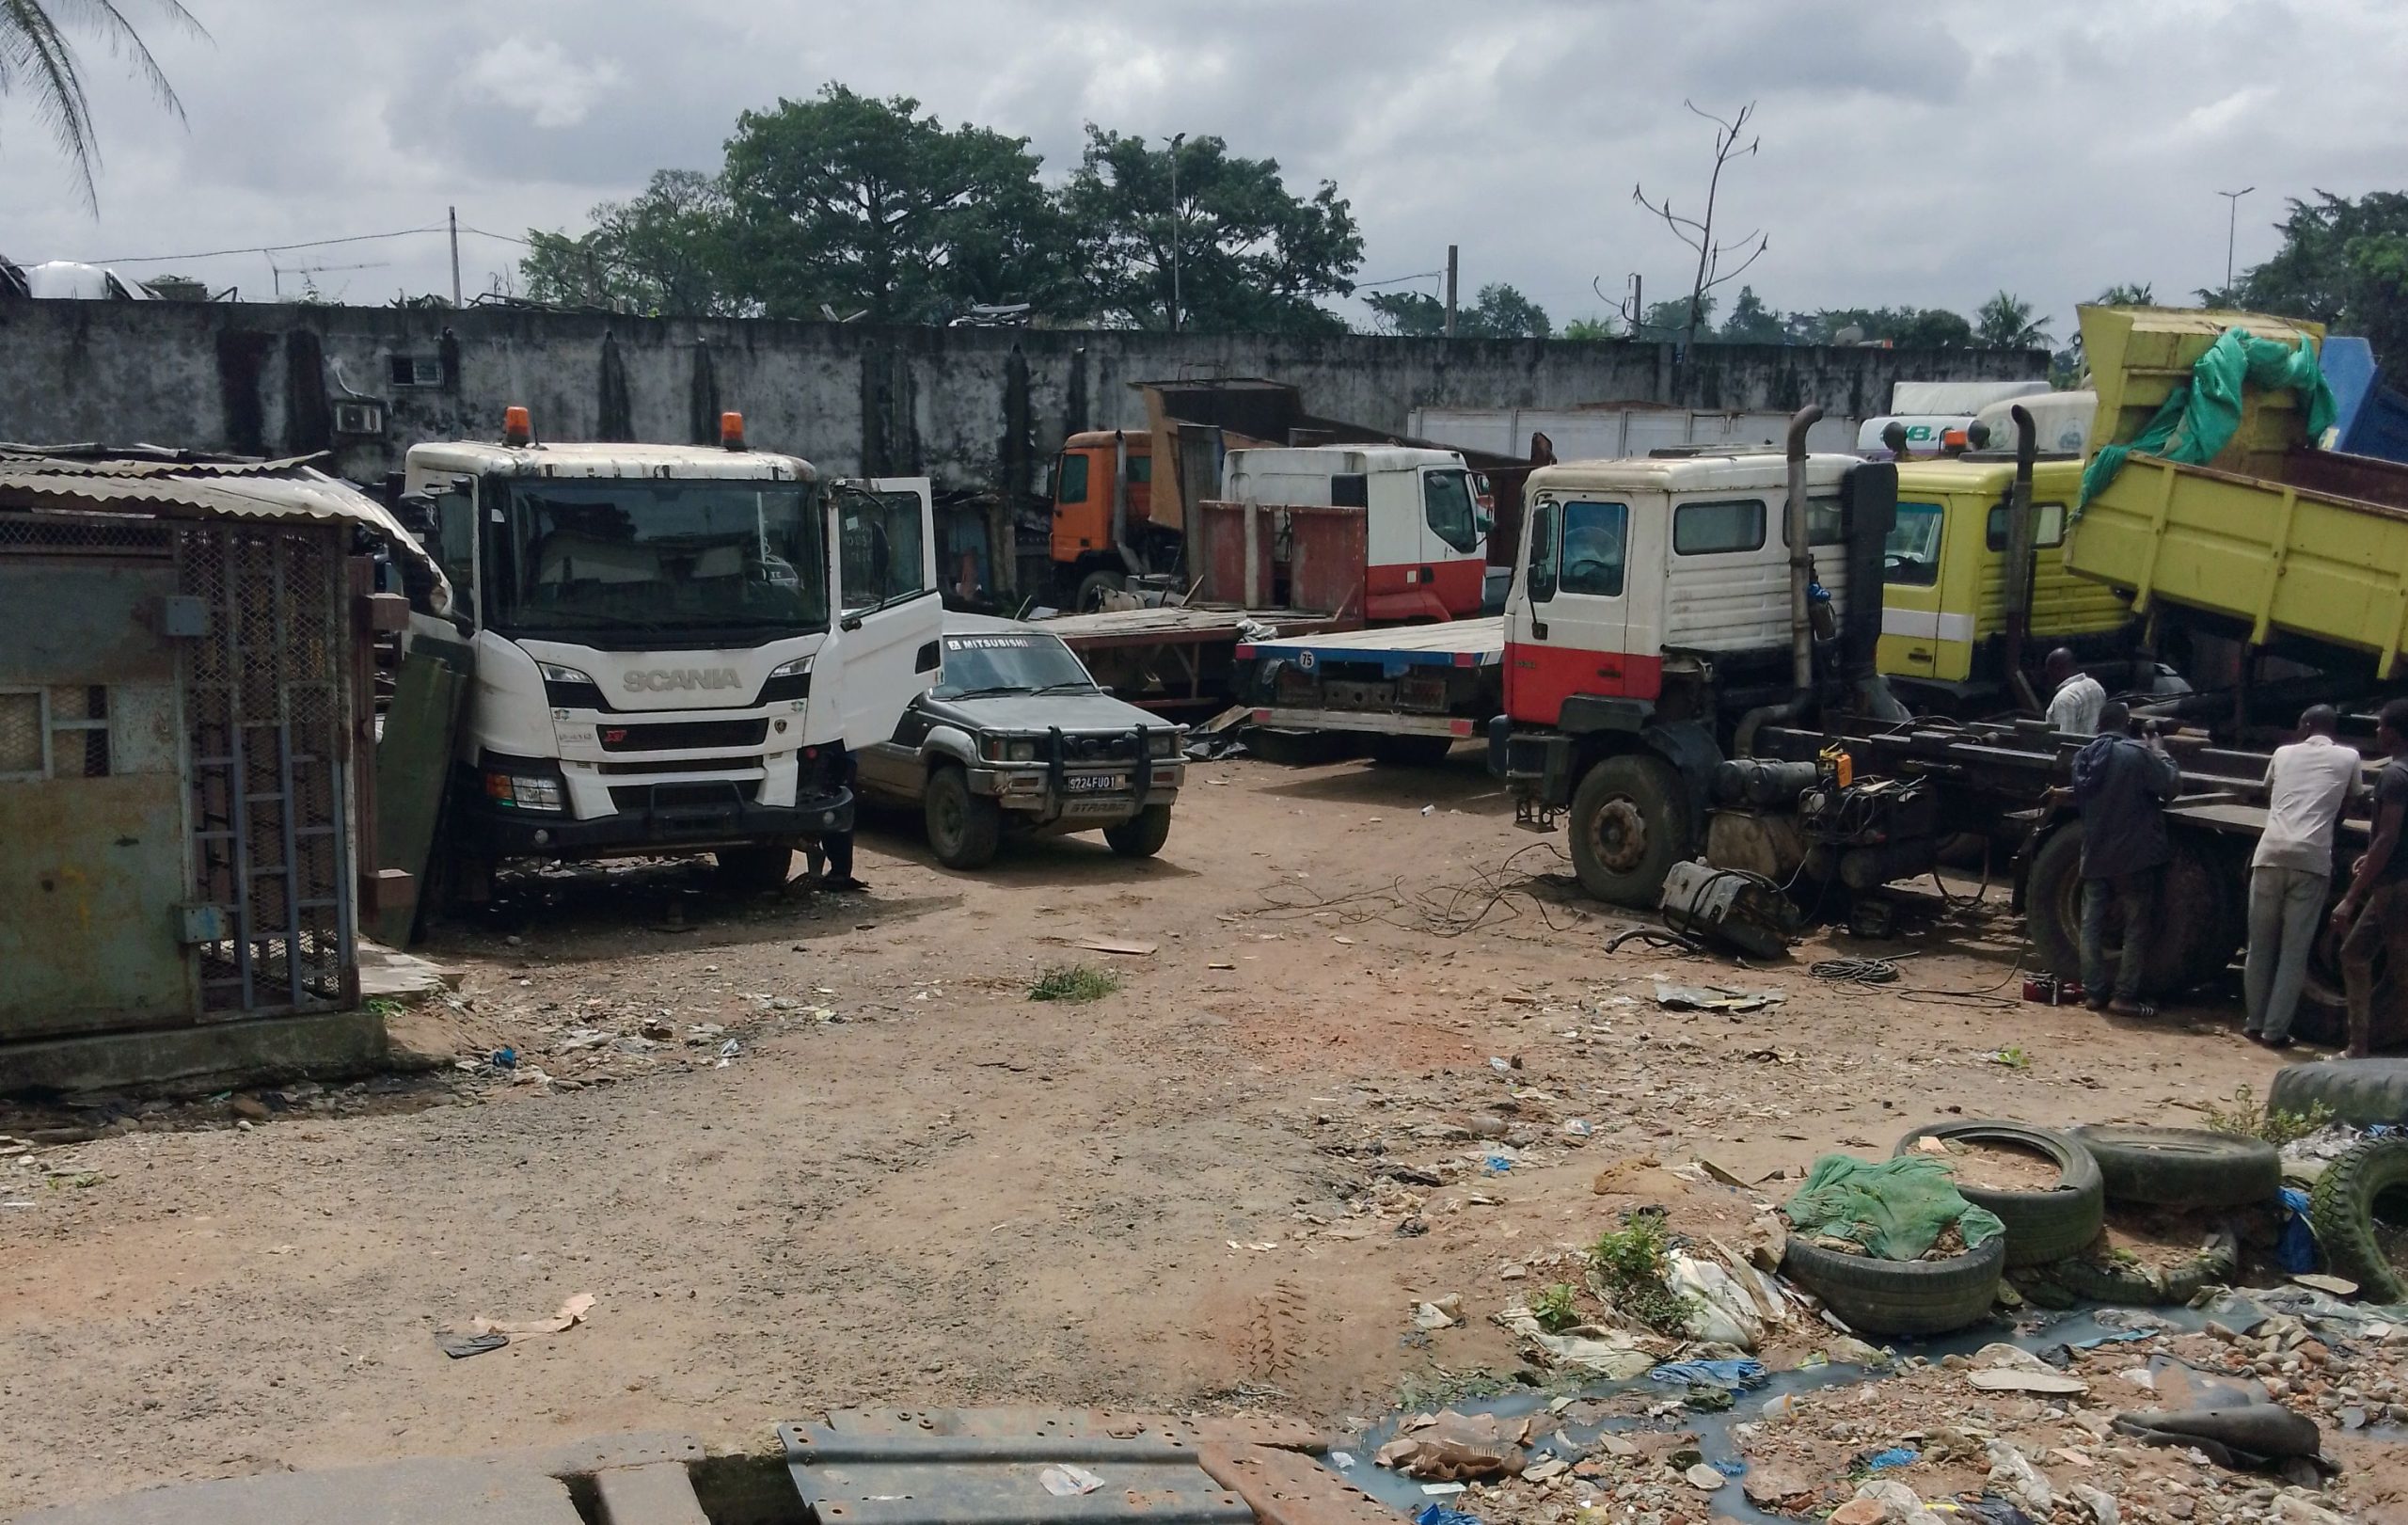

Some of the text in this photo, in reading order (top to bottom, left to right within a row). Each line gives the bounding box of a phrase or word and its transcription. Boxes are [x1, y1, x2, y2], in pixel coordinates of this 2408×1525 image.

[962, 639, 1029, 650] MITSUBISHI
[1302, 653, 1313, 666] 75
[623, 668, 743, 693] SCANIA
